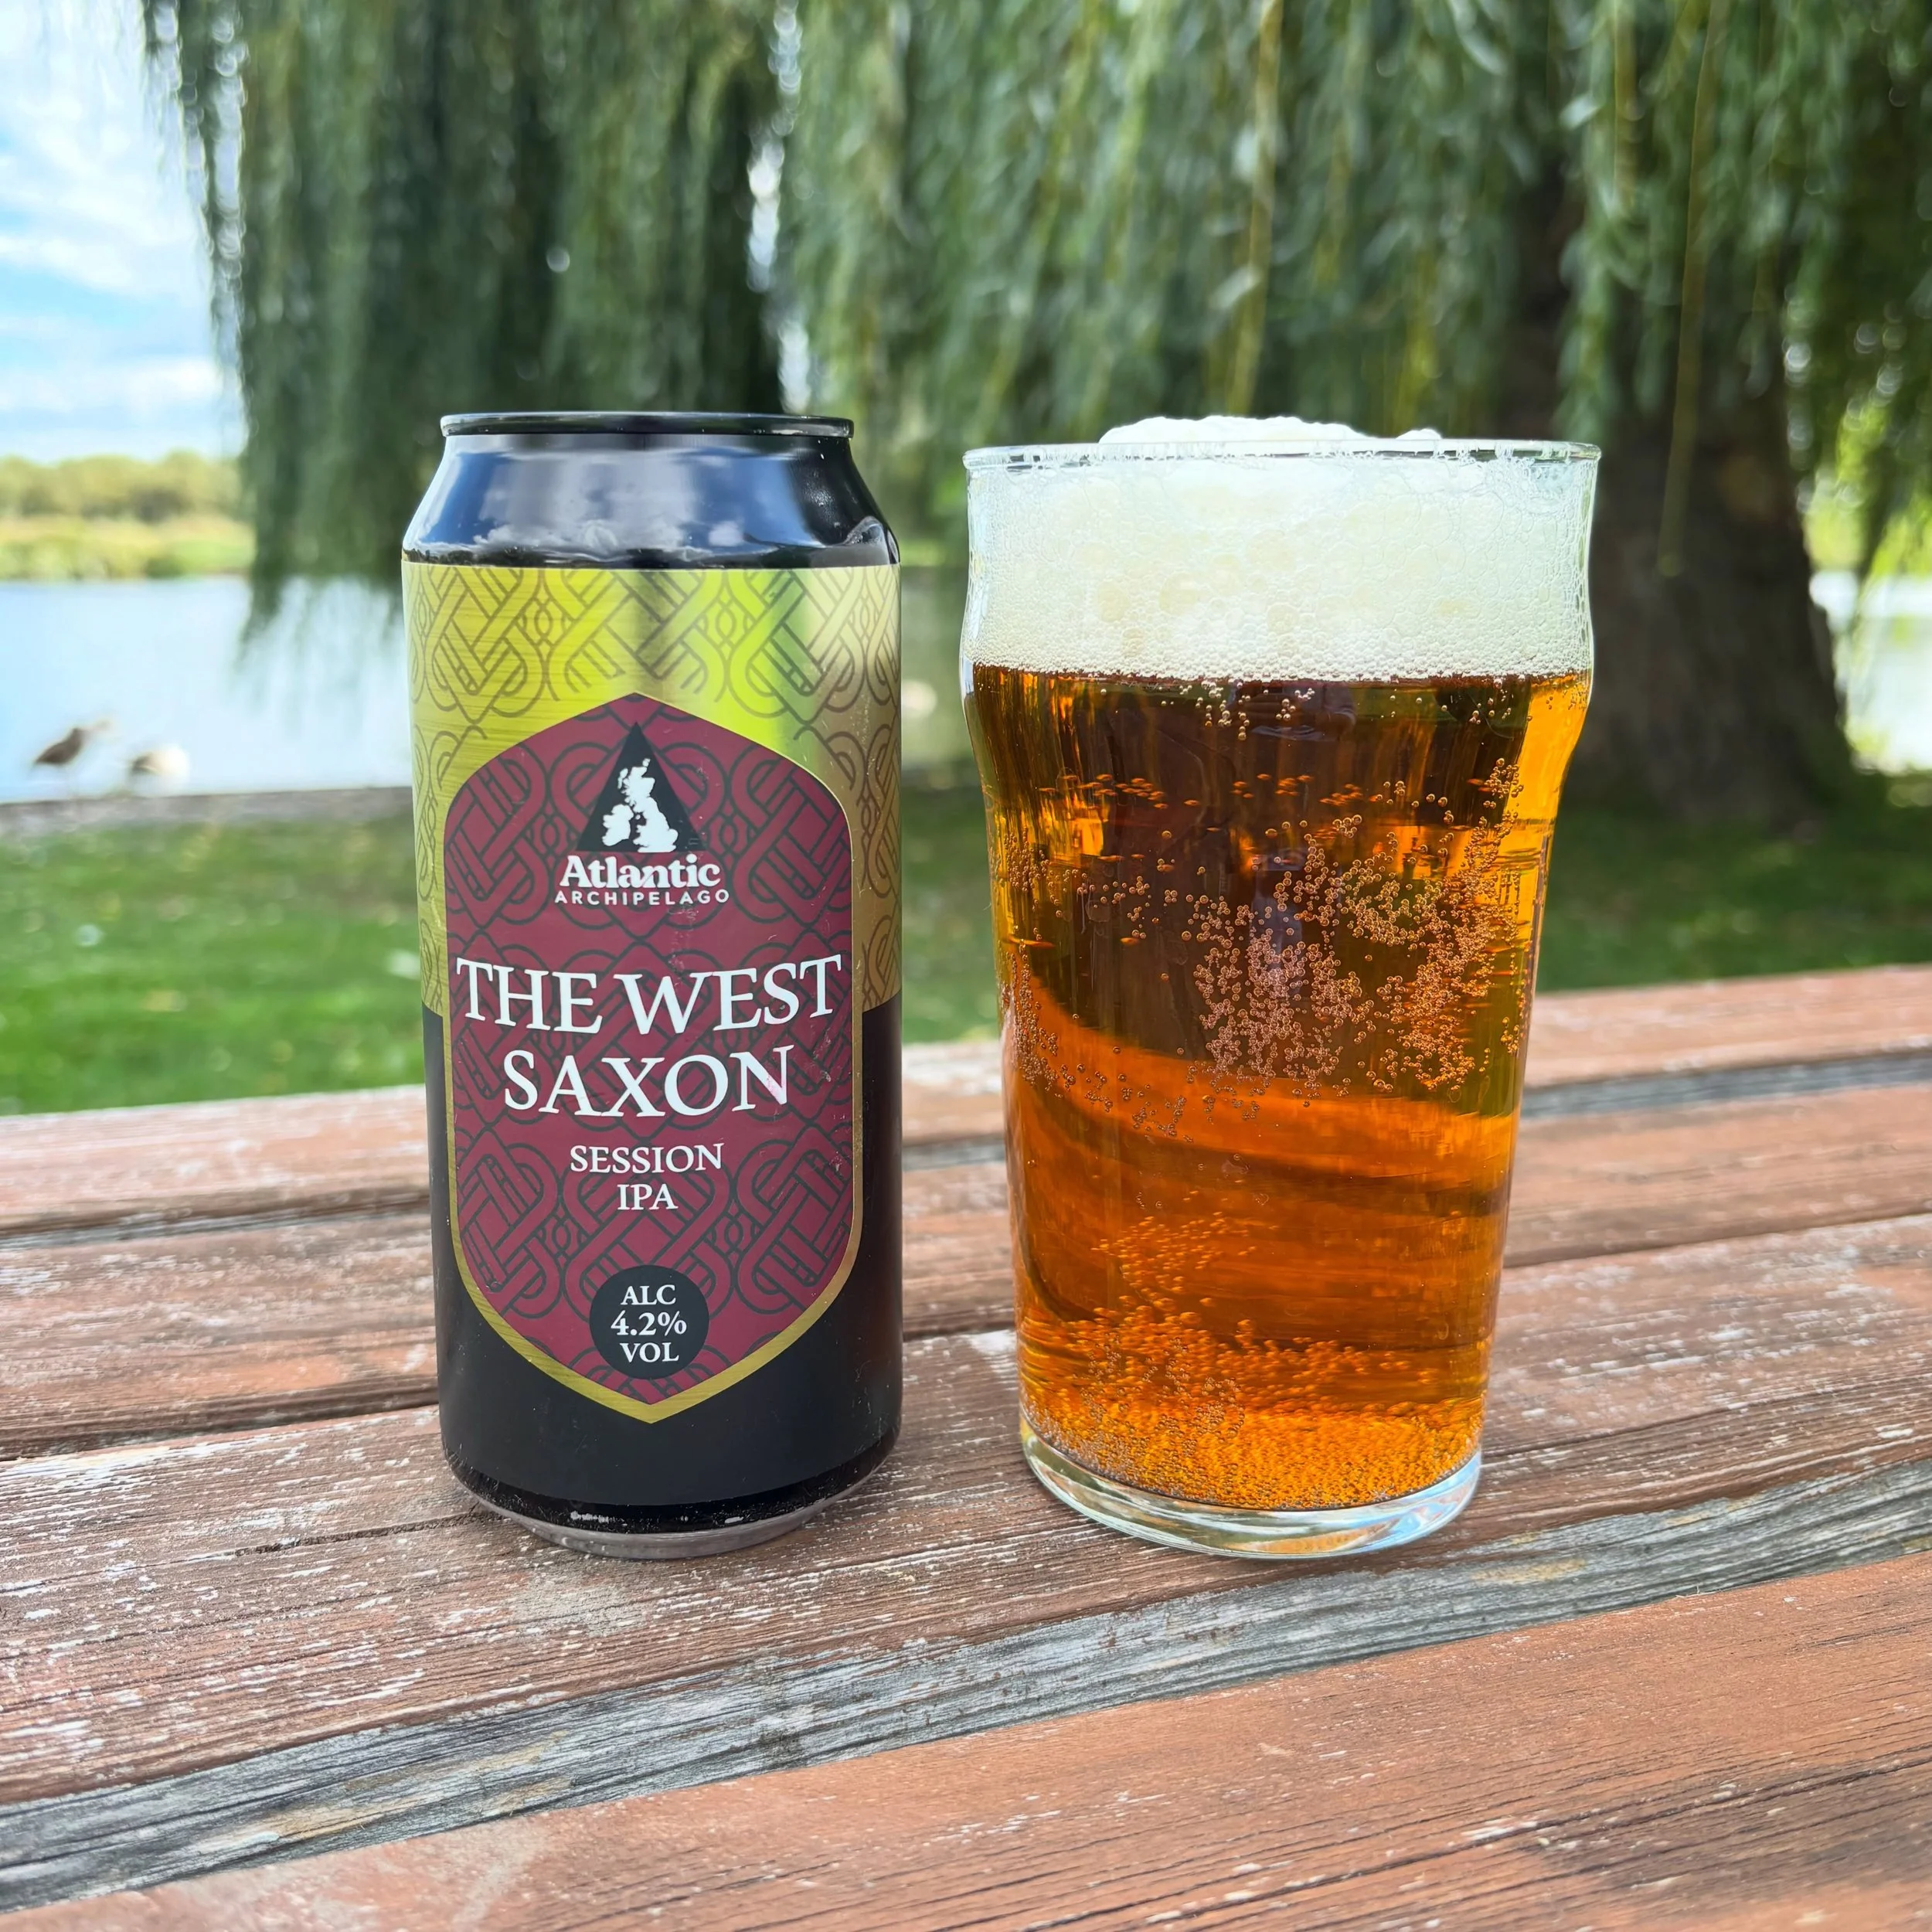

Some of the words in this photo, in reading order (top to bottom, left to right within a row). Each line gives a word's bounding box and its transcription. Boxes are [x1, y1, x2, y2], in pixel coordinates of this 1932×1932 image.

[560, 854, 721, 889] Atlantic
[554, 888, 730, 906] ARCHIPELAGO
[456, 957, 603, 1035] THE
[614, 954, 842, 1034] WEST
[503, 1045, 794, 1117] SAXON
[570, 1142, 724, 1174] SESSION
[617, 1183, 678, 1211] IPA
[621, 1284, 676, 1305] ALC
[611, 1310, 687, 1336] 4.2%
[620, 1342, 679, 1362] VOL
